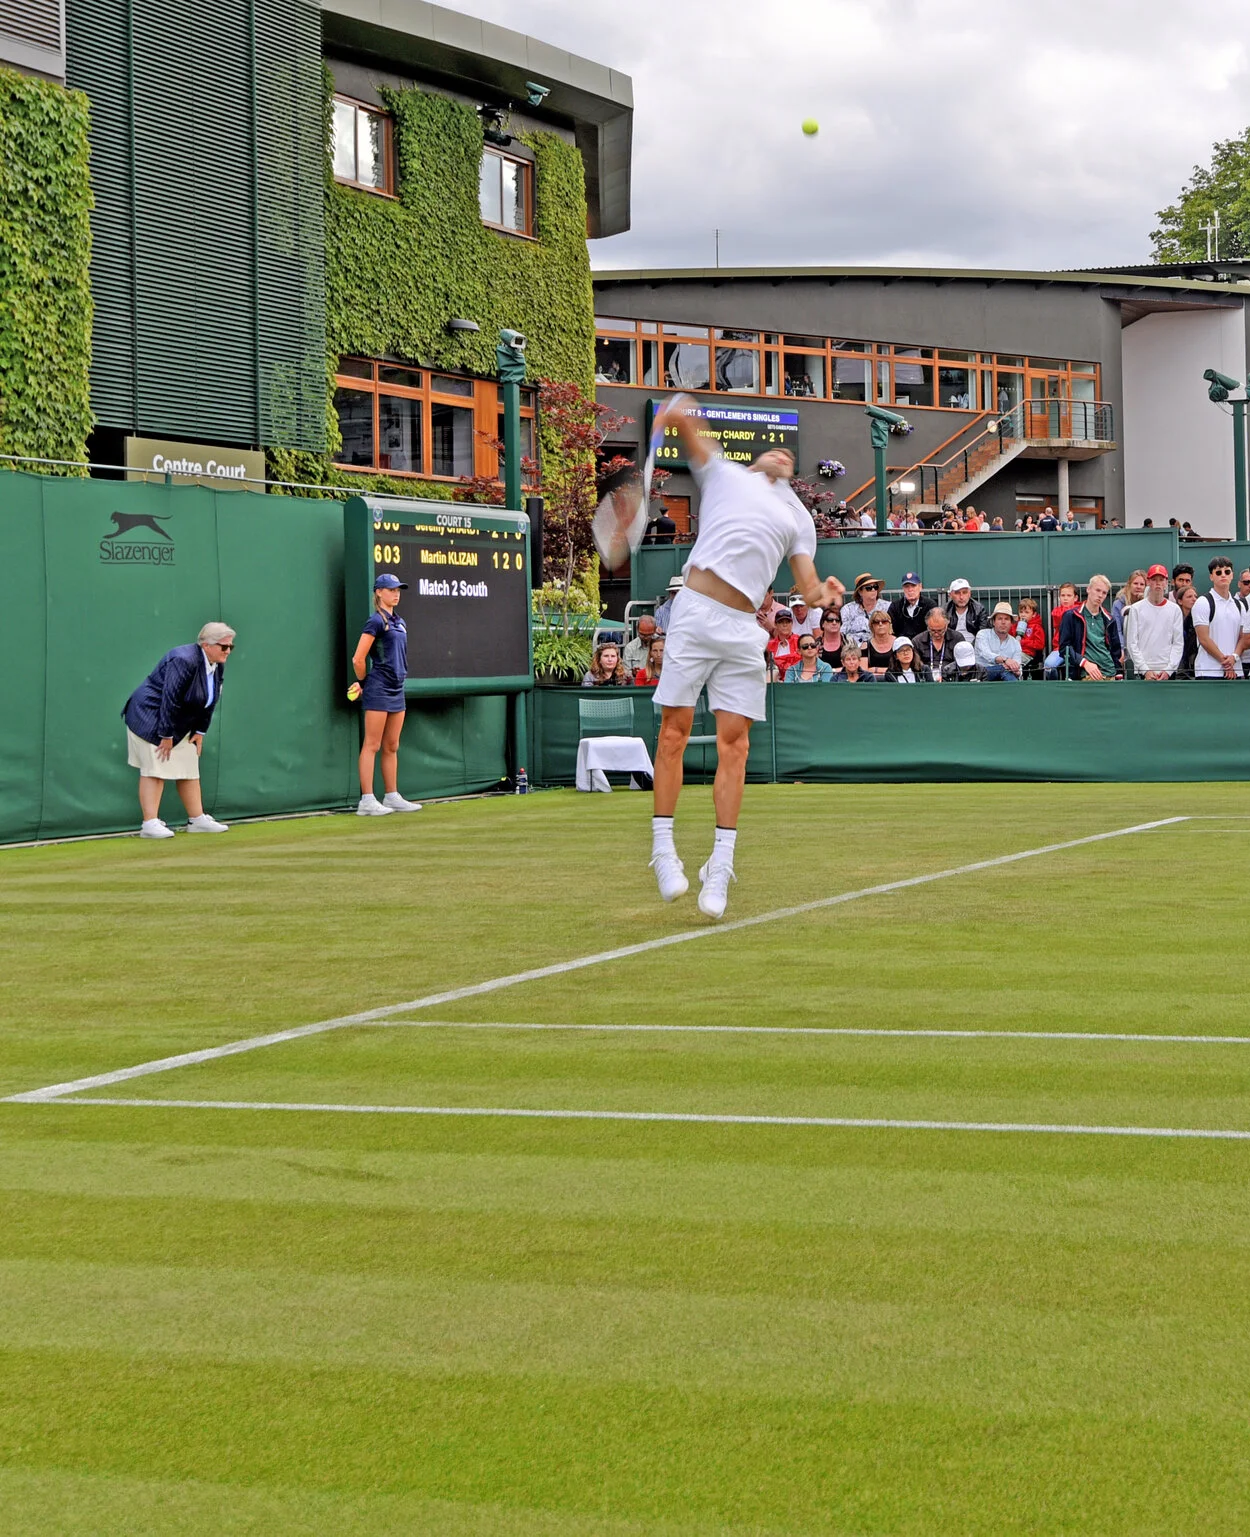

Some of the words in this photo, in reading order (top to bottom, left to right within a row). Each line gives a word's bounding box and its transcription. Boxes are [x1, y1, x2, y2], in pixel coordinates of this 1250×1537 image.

[697, 409, 702, 417] 9
[706, 410, 751, 421] GENTLEMEN'S
[752, 413, 780, 423] SINGLES
[696, 428, 721, 440] Jeremy
[723, 429, 755, 440] CHARDY
[723, 451, 752, 461] KLIZAN
[153, 454, 202, 477] Centre
[206, 460, 246, 479] Court
[436, 514, 462, 527] COURT
[463, 516, 472, 528] 15
[99, 540, 175, 566] Slazenger
[420, 549, 447, 565] Martin
[449, 550, 478, 567] KLIZAN
[419, 578, 450, 597] Match
[451, 580, 459, 597] 2
[459, 580, 488, 598] South
